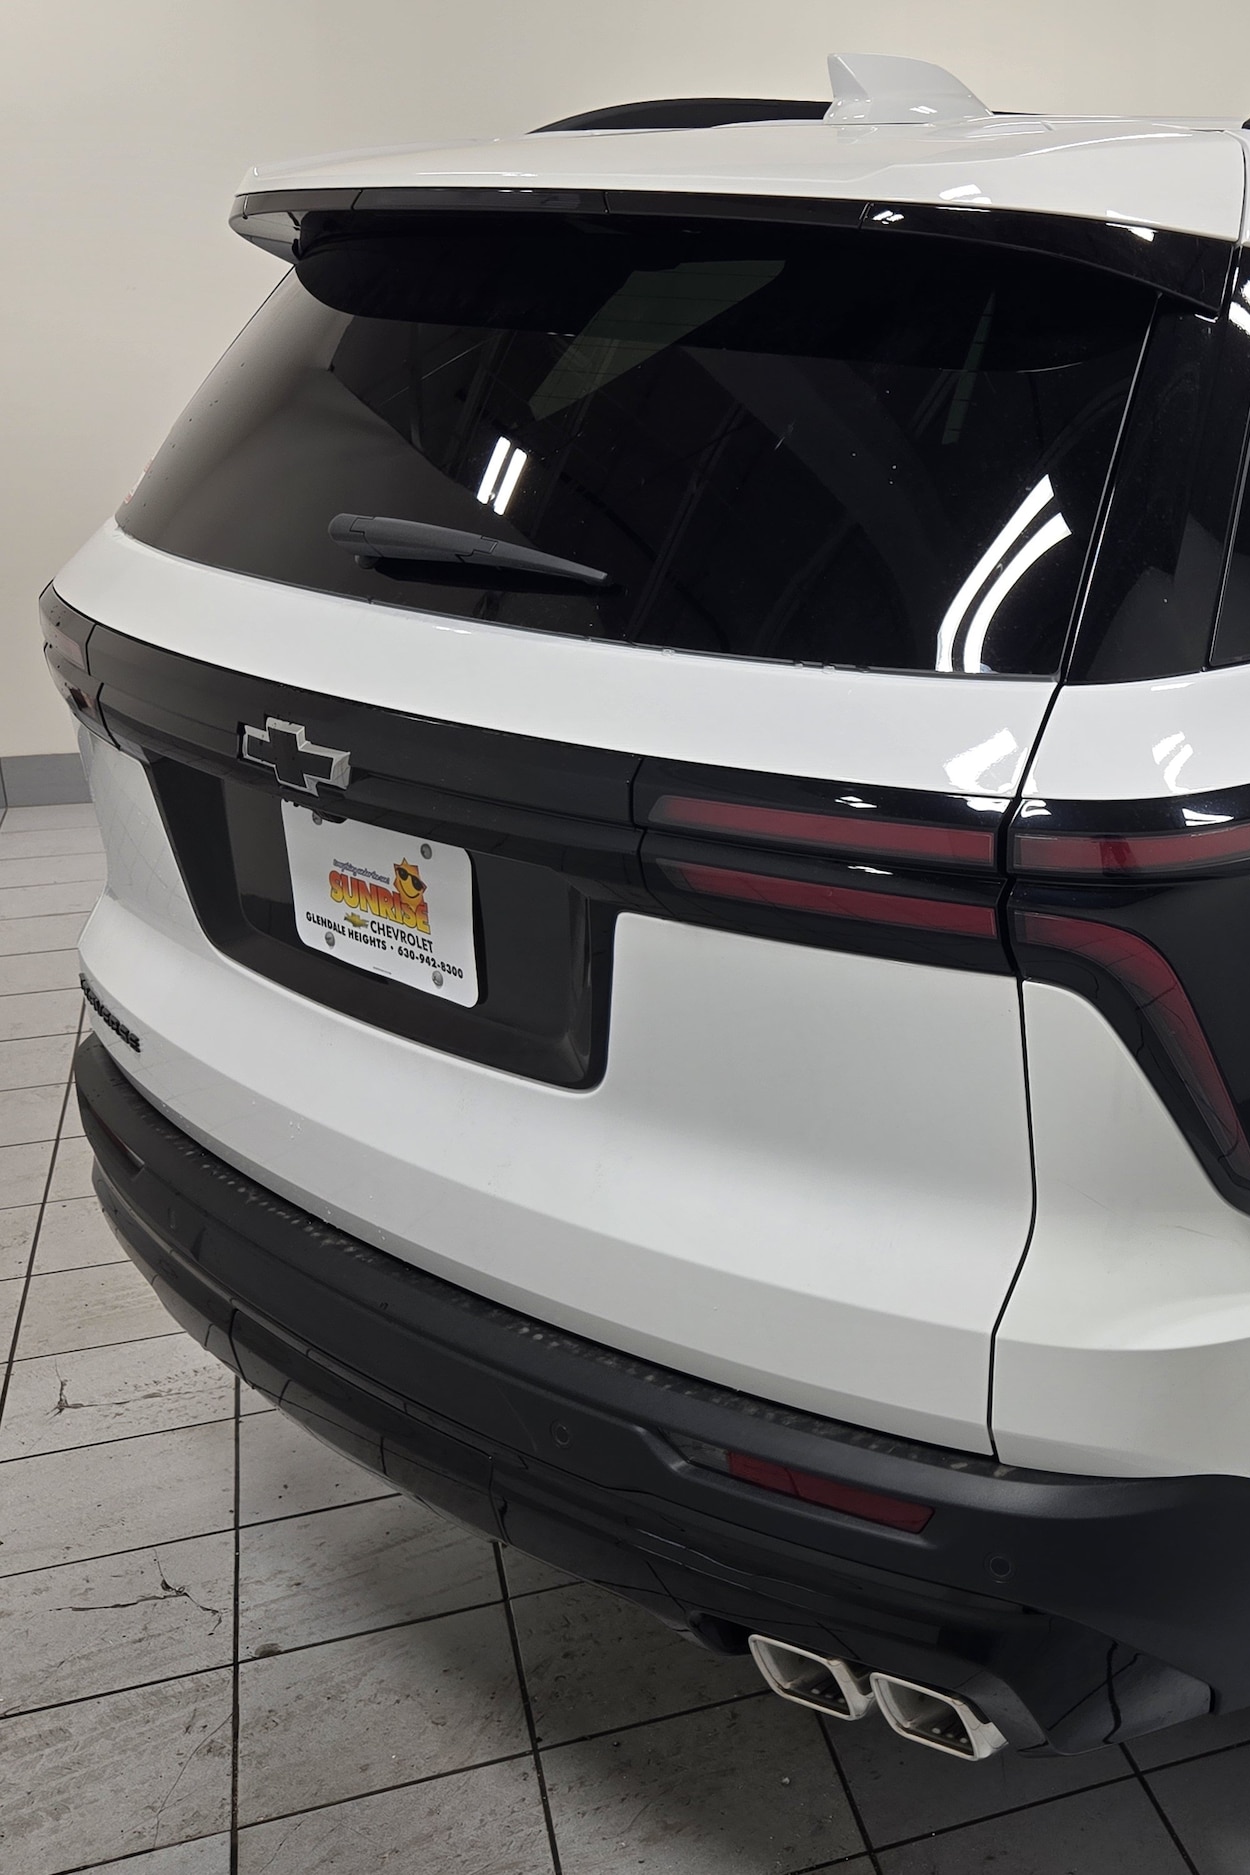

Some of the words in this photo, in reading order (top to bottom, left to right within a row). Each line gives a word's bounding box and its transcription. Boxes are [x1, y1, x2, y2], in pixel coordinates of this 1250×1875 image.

[328, 870, 431, 935] SUNRISE
[306, 911, 346, 937] GLENDALE
[348, 927, 387, 950] HEIGHTS
[397, 946, 464, 979] 630-942-8300
[370, 920, 434, 953] CHEVROLET
